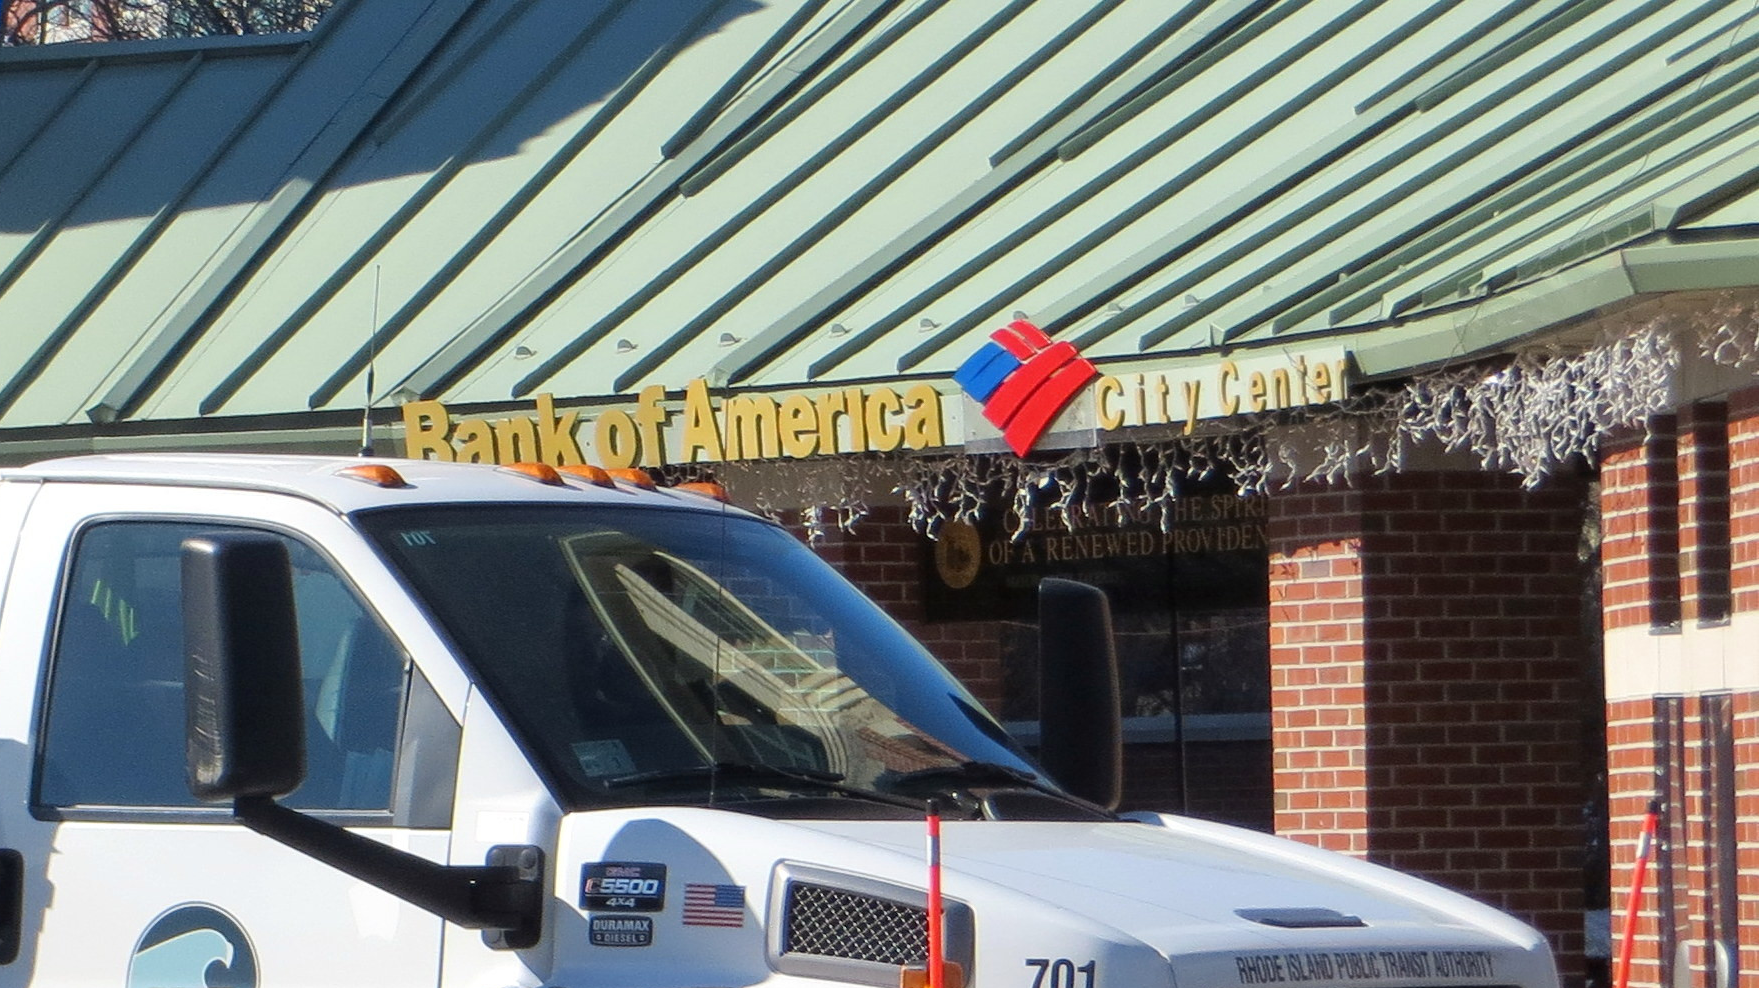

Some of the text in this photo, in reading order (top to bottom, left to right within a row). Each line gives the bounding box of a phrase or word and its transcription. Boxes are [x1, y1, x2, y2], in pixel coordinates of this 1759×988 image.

[1096, 353, 1350, 436] City Center
[403, 378, 945, 468] Bank of America
[1161, 495, 1204, 522] HE
[988, 523, 1270, 566] OF A RENEWED PROVIDEN
[584, 877, 659, 895] C5500
[592, 919, 650, 932] DURAMAX
[604, 933, 638, 942] DIESEL
[1234, 950, 1494, 985] RHODE ISLAND PUBLIC TRANSIT AUTHORITY
